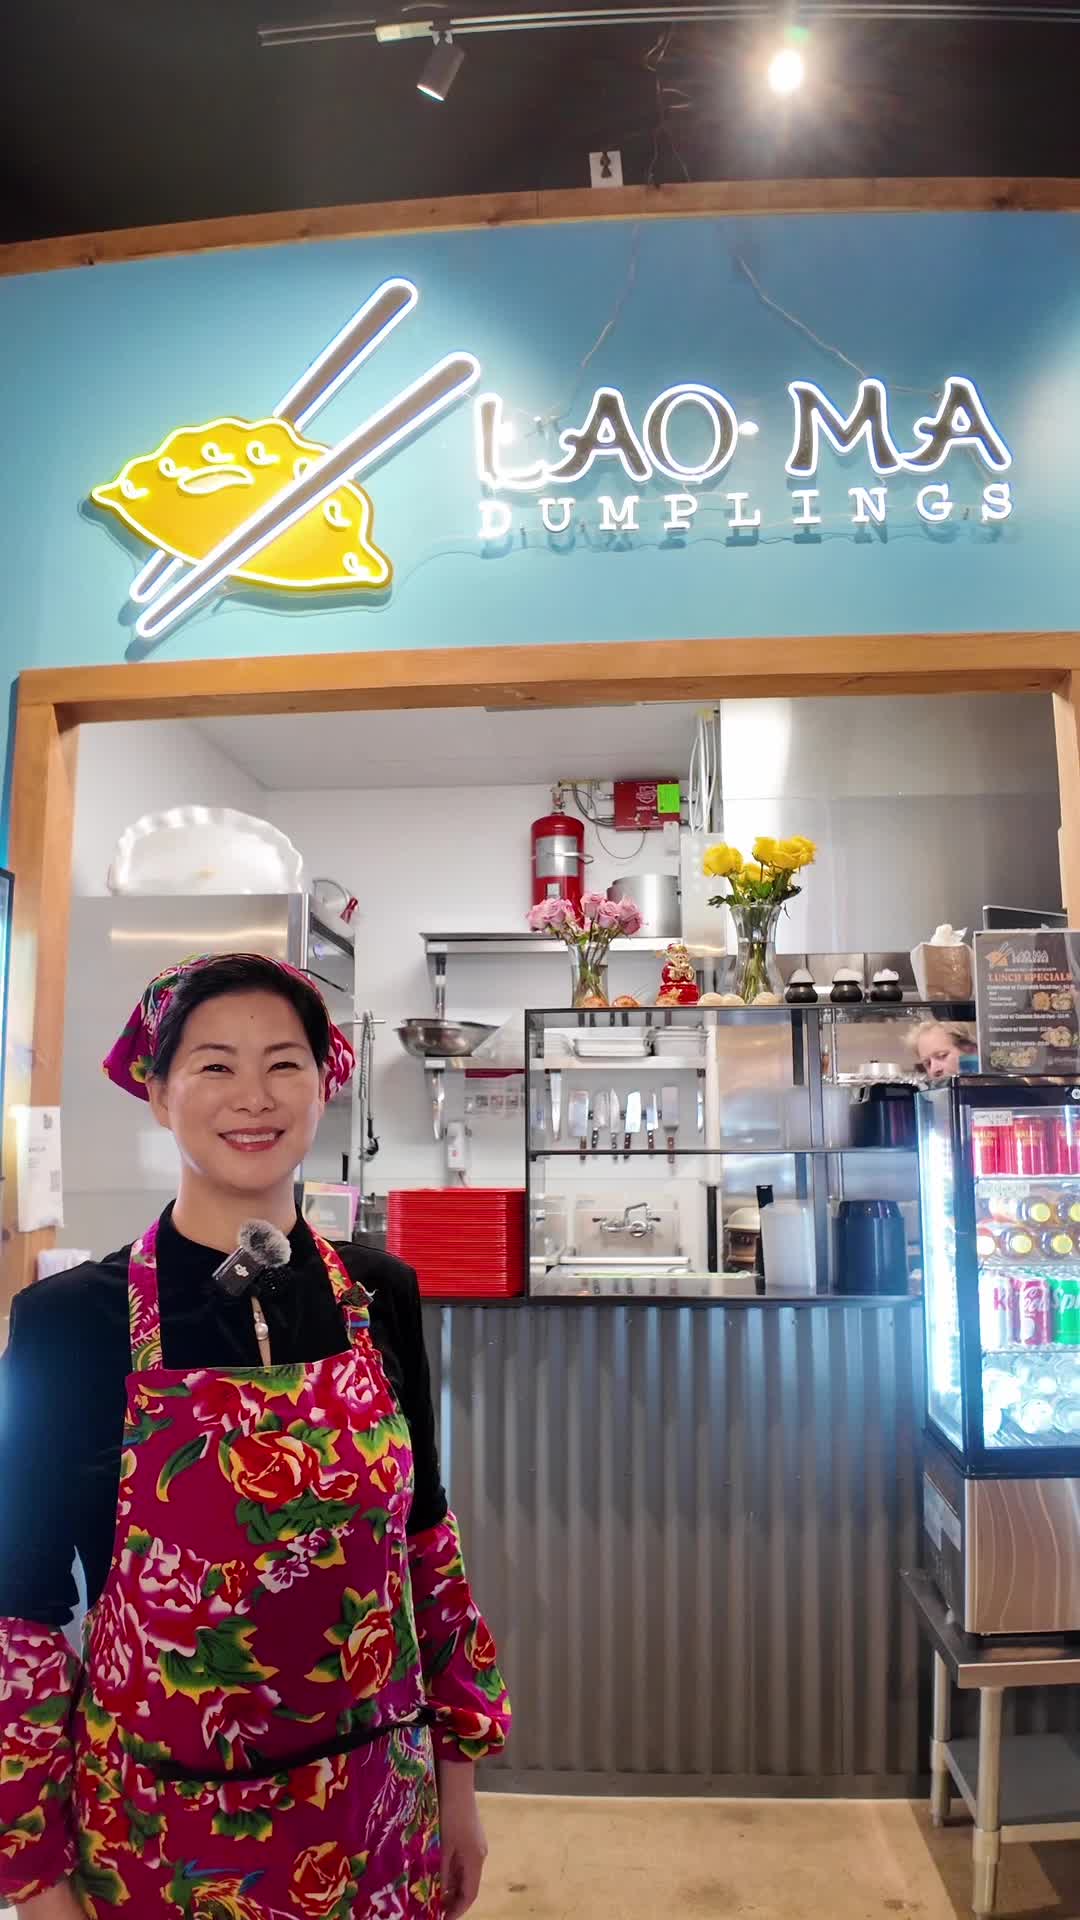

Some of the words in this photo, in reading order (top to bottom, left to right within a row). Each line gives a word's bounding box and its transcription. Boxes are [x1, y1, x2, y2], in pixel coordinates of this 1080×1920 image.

[476, 382, 738, 489] LAO
[785, 376, 1014, 477] MA
[479, 483, 1015, 538] DUMPLINGS
[988, 972, 1021, 982] LUNCH
[1023, 972, 1073, 982] SPECIALS
